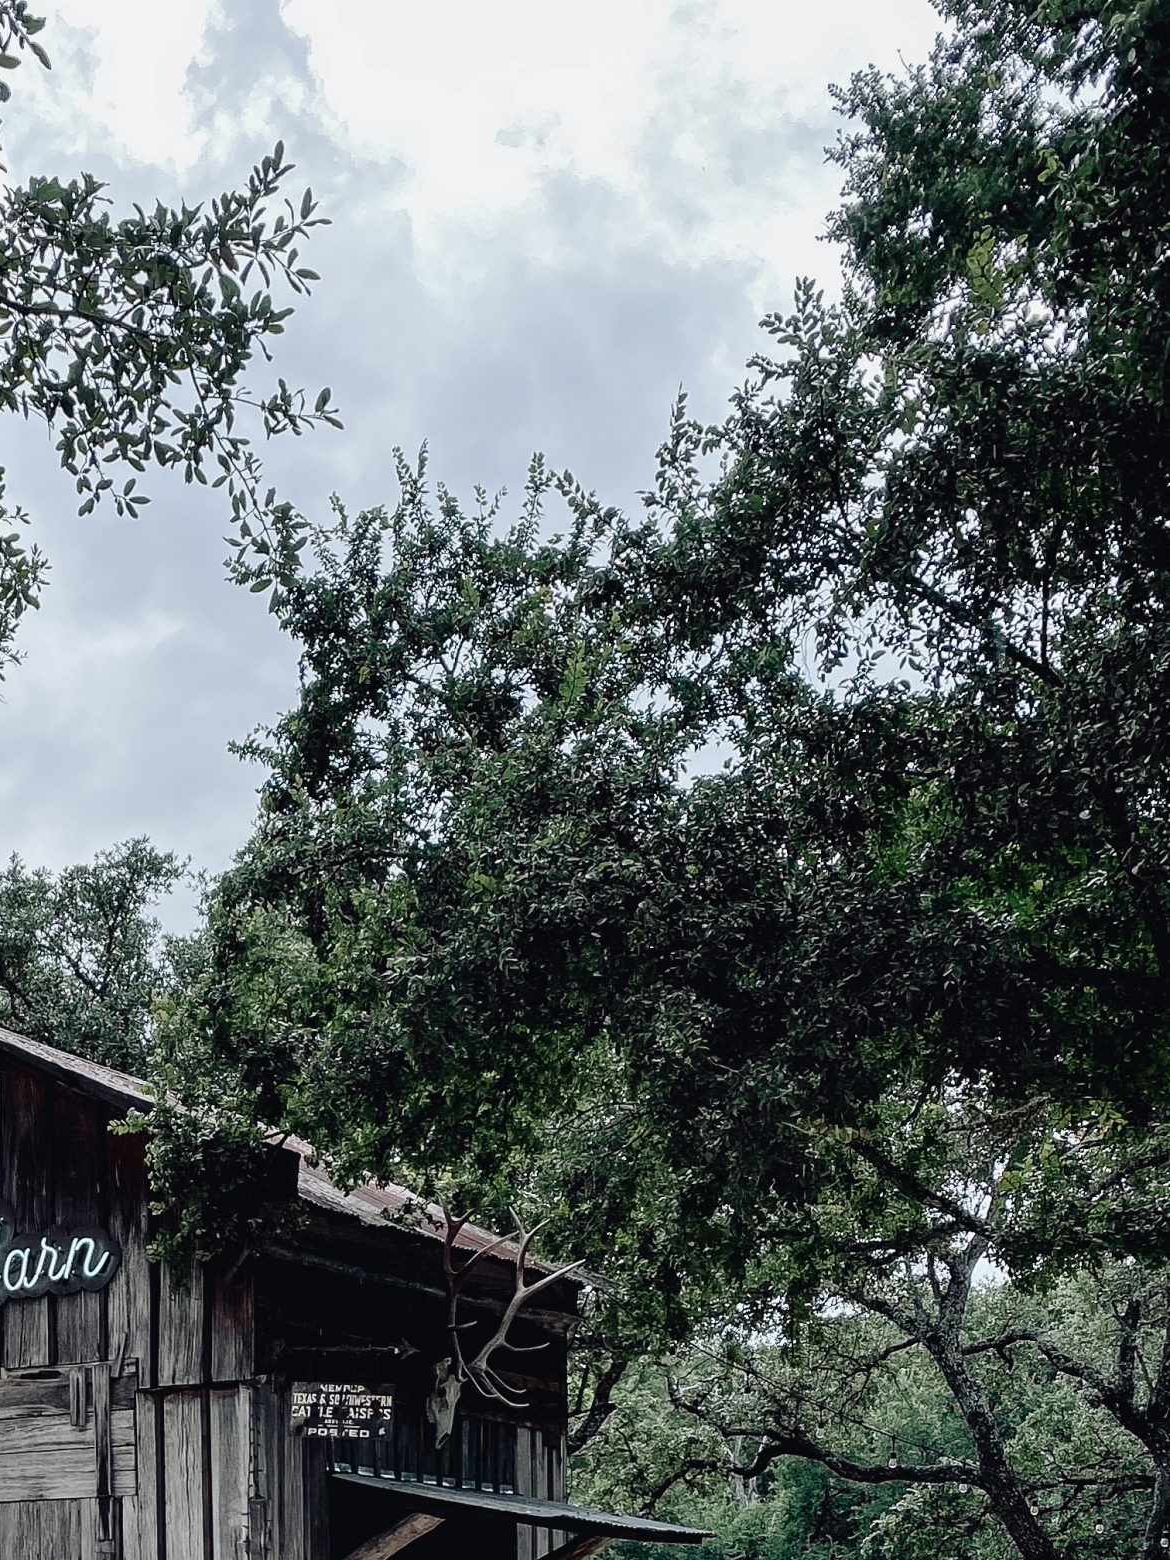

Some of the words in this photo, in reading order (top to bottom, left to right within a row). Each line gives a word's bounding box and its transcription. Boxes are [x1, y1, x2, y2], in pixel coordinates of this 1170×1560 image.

[292, 1392, 317, 1405] TEXAS
[319, 1394, 327, 1406] &
[290, 1405, 334, 1418] CATLE
[341, 1406, 392, 1420] AISES
